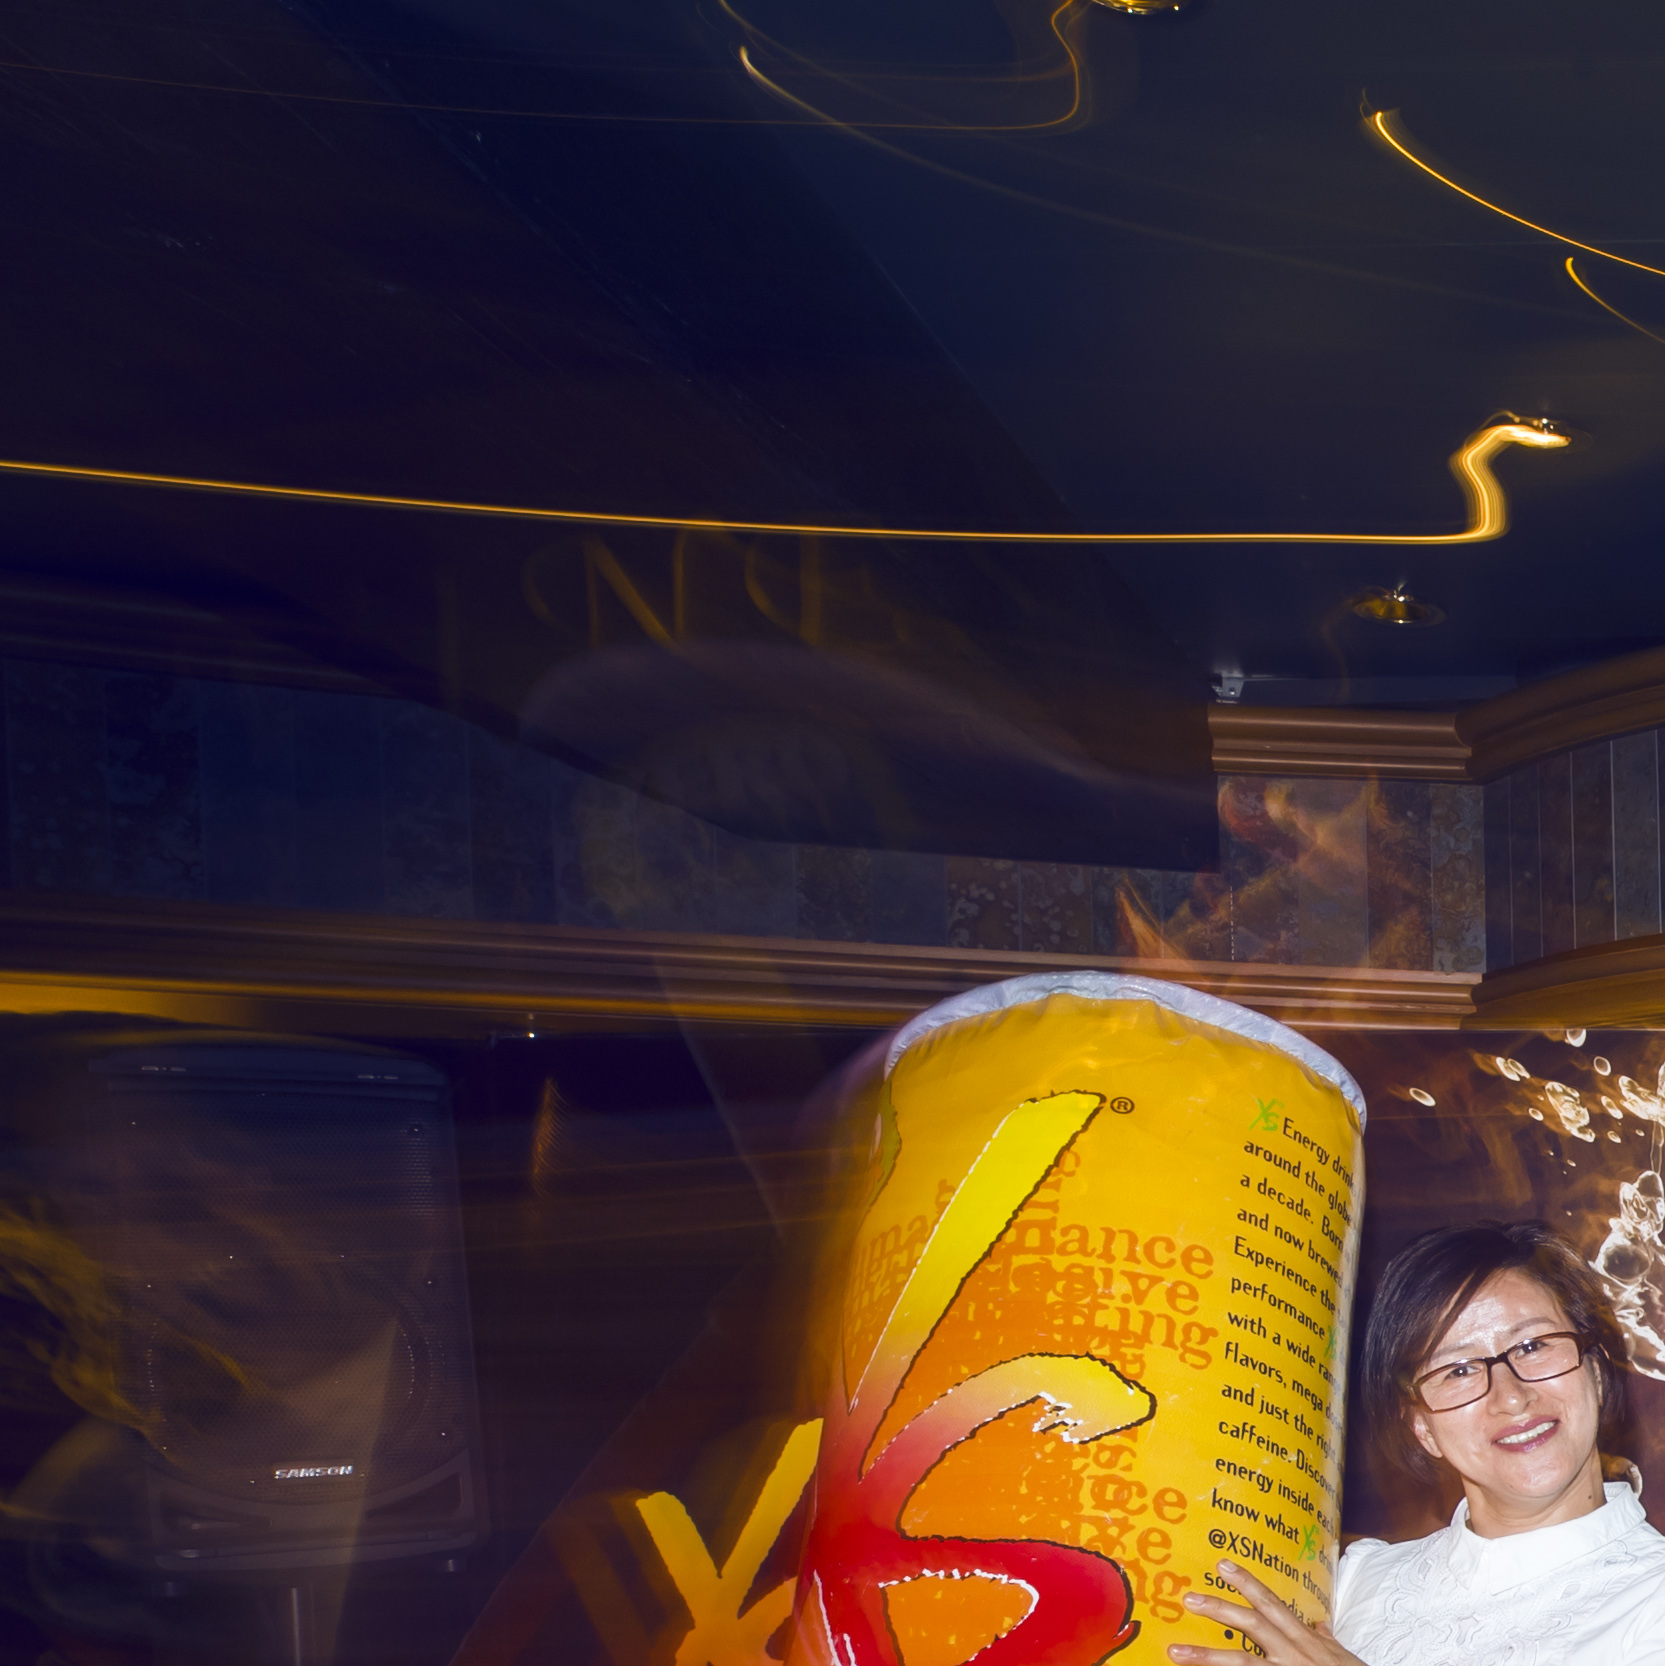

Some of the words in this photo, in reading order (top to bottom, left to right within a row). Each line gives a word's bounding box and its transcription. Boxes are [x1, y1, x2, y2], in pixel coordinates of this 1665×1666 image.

[1244, 1140, 1302, 1179] around
[1305, 1170, 1326, 1198] the
[1282, 1117, 1330, 1166] Energy
[1240, 1174, 1250, 1188] a
[1257, 1177, 1314, 1225] decade.
[1237, 1208, 1269, 1232] and
[1275, 1225, 1304, 1252] now
[1234, 1235, 1317, 1297] Experience
[1320, 1289, 1336, 1316] the
[1231, 1277, 1325, 1340] performance
[1227, 1312, 1267, 1339] with
[1272, 1331, 1281, 1346] a
[1286, 1338, 1316, 1369] wide
[1225, 1341, 1287, 1389] flavors,
[1292, 1378, 1324, 1412] mega
[1222, 1384, 1255, 1407] and
[1259, 1396, 1290, 1426] just
[1293, 1413, 1314, 1440] the
[1218, 1421, 1292, 1463] caffeine.
[275, 1465, 354, 1480] SAMSON
[1215, 1458, 1274, 1493] energy
[1278, 1478, 1315, 1516] inside
[1211, 1487, 1260, 1522] know
[1265, 1513, 1299, 1545] what
[1208, 1528, 1299, 1583] @XSNation
